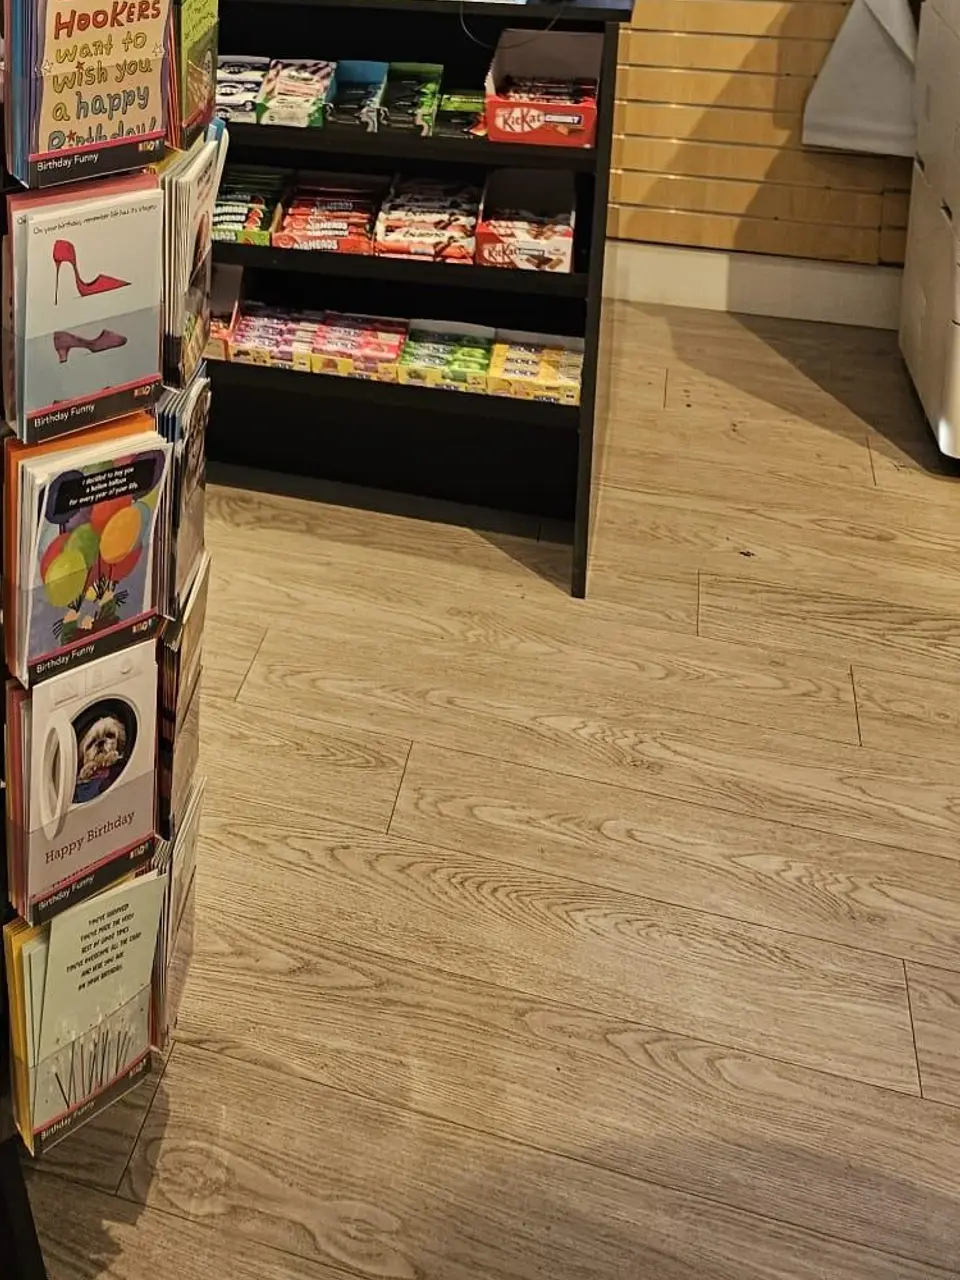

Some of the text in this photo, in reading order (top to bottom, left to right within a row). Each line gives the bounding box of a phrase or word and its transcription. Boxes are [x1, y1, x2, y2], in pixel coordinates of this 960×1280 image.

[55, 31, 147, 64] want to
[53, 59, 152, 93] wish you
[52, 85, 150, 121] a happy
[501, 107, 544, 132] KitKat
[37, 152, 99, 171] Birthday Funny
[487, 242, 517, 263] KitKat
[34, 403, 95, 428] Birthday Funny
[36, 644, 96, 673] Birthday Funny
[44, 811, 135, 864] Happy Birthday
[39, 874, 95, 909] Birthday Funny
[40, 1117, 71, 1140] Birthday
